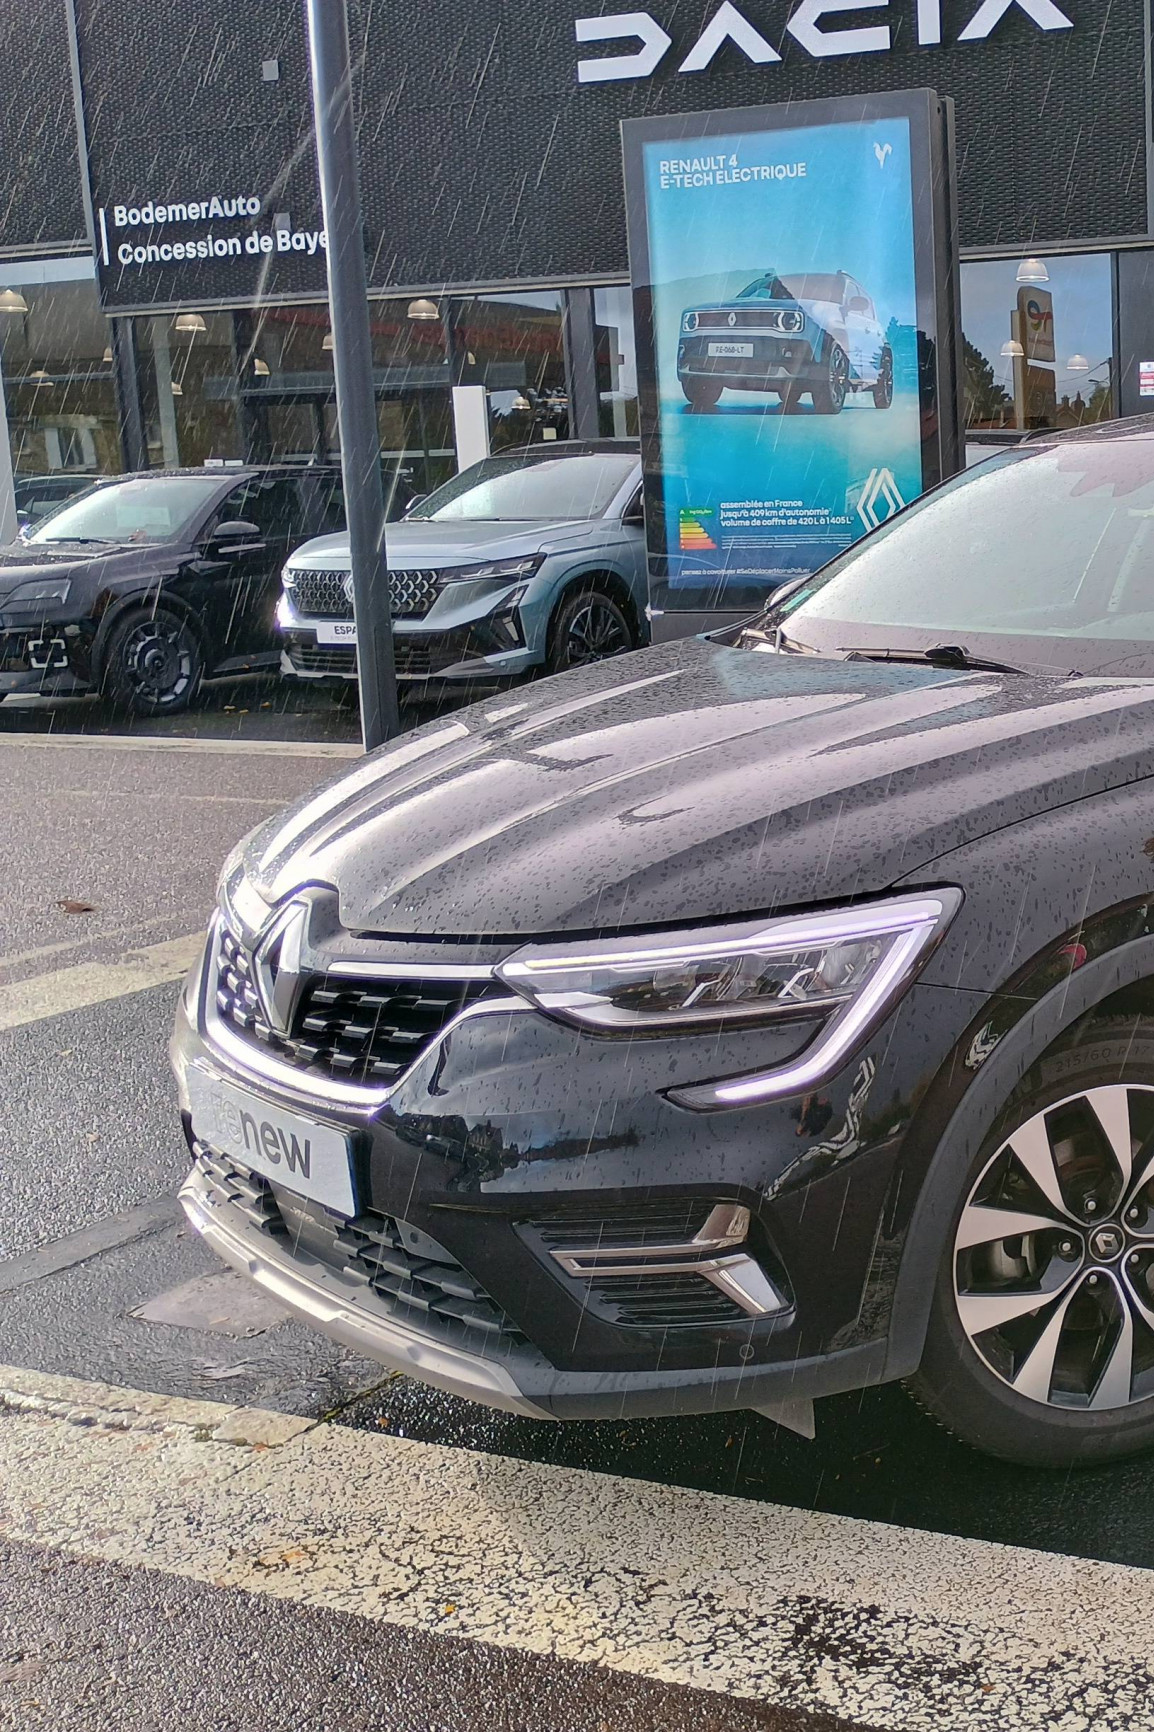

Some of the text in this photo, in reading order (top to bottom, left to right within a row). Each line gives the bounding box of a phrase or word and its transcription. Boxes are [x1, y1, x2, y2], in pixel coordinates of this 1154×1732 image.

[575, 0, 1074, 83] DACIA
[660, 154, 738, 174] RENAULT 4
[660, 163, 807, 189] E-TECH ELECTRIQUE
[114, 195, 261, 227] BodemerAuto
[118, 229, 329, 265] Concession de Baye
[720, 499, 803, 509] assemblée en France
[720, 509, 749, 519] jusqu'à
[750, 508, 765, 517] 409
[765, 508, 778, 517] km
[720, 518, 750, 527] volume
[751, 518, 760, 526] de
[760, 517, 786, 526] coffre
[787, 517, 797, 526] de
[798, 517, 813, 525] 420
[334, 625, 357, 635] ESPA
[210, 1091, 311, 1180] renew
